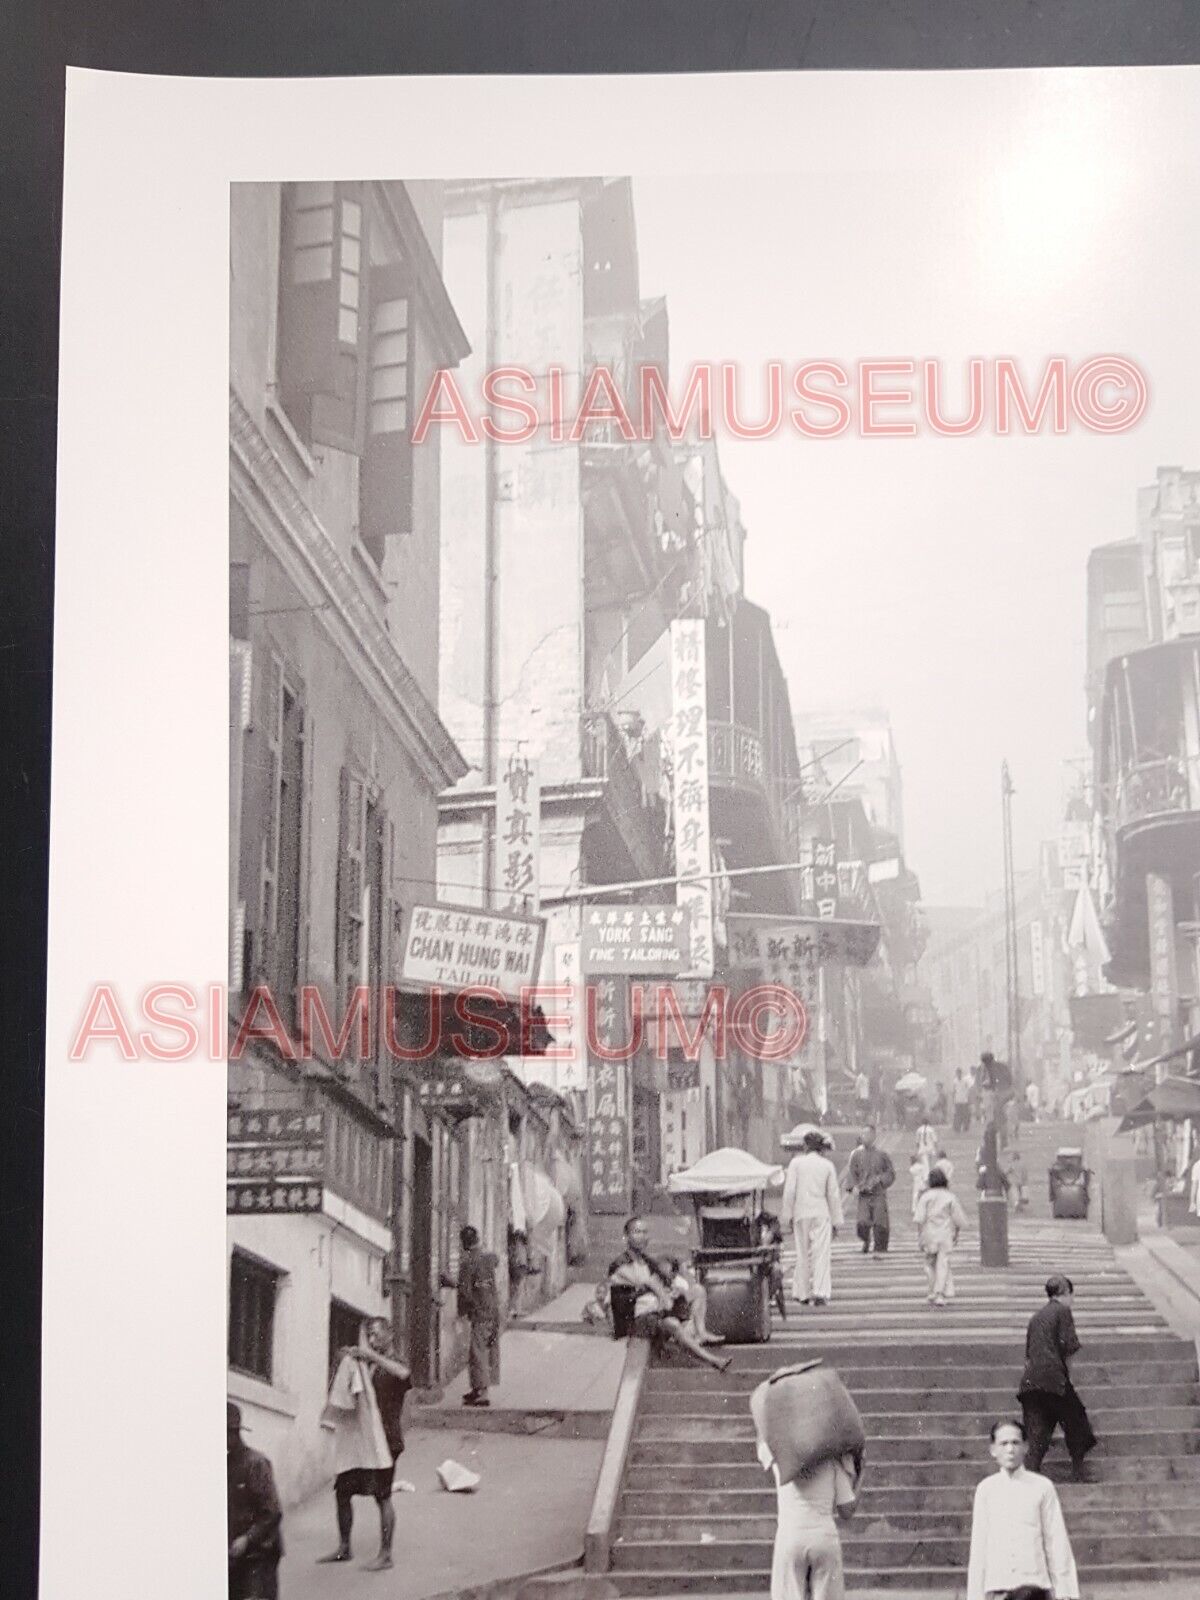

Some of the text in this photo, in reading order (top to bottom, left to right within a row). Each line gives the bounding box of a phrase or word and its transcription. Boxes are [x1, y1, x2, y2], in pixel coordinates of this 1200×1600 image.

[598, 926, 674, 943] YORK SANG
[409, 936, 531, 975] CHAN HUNG WAI
[588, 947, 681, 961] FINE TAILORING
[435, 966, 501, 988] TAILOR
